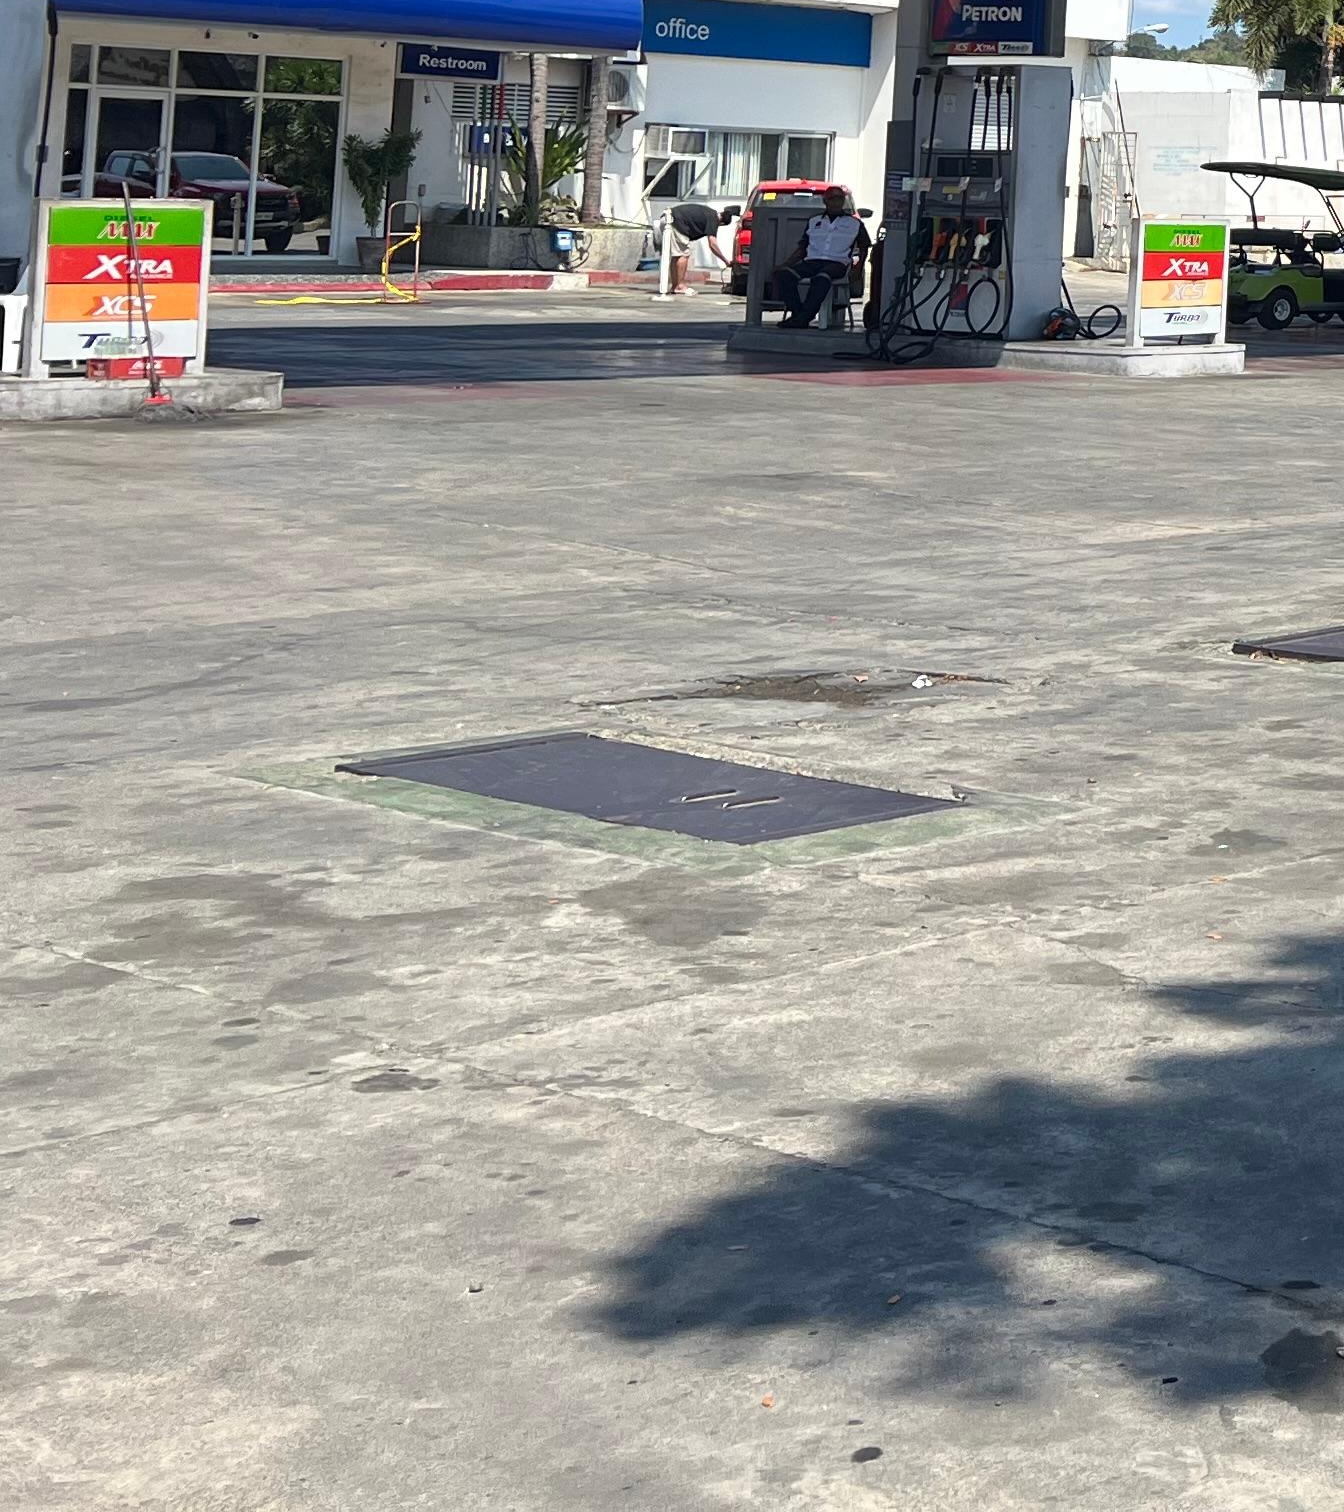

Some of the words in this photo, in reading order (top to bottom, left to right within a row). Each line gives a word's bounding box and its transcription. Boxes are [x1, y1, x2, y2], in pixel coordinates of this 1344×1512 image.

[962, 5, 1022, 22] PETRON
[655, 17, 710, 40] office
[419, 54, 487, 71] Restroom
[82, 254, 173, 279] XTRA
[1161, 258, 1209, 276] XTRA
[1162, 282, 1206, 301] XCS
[83, 295, 157, 317] XCS
